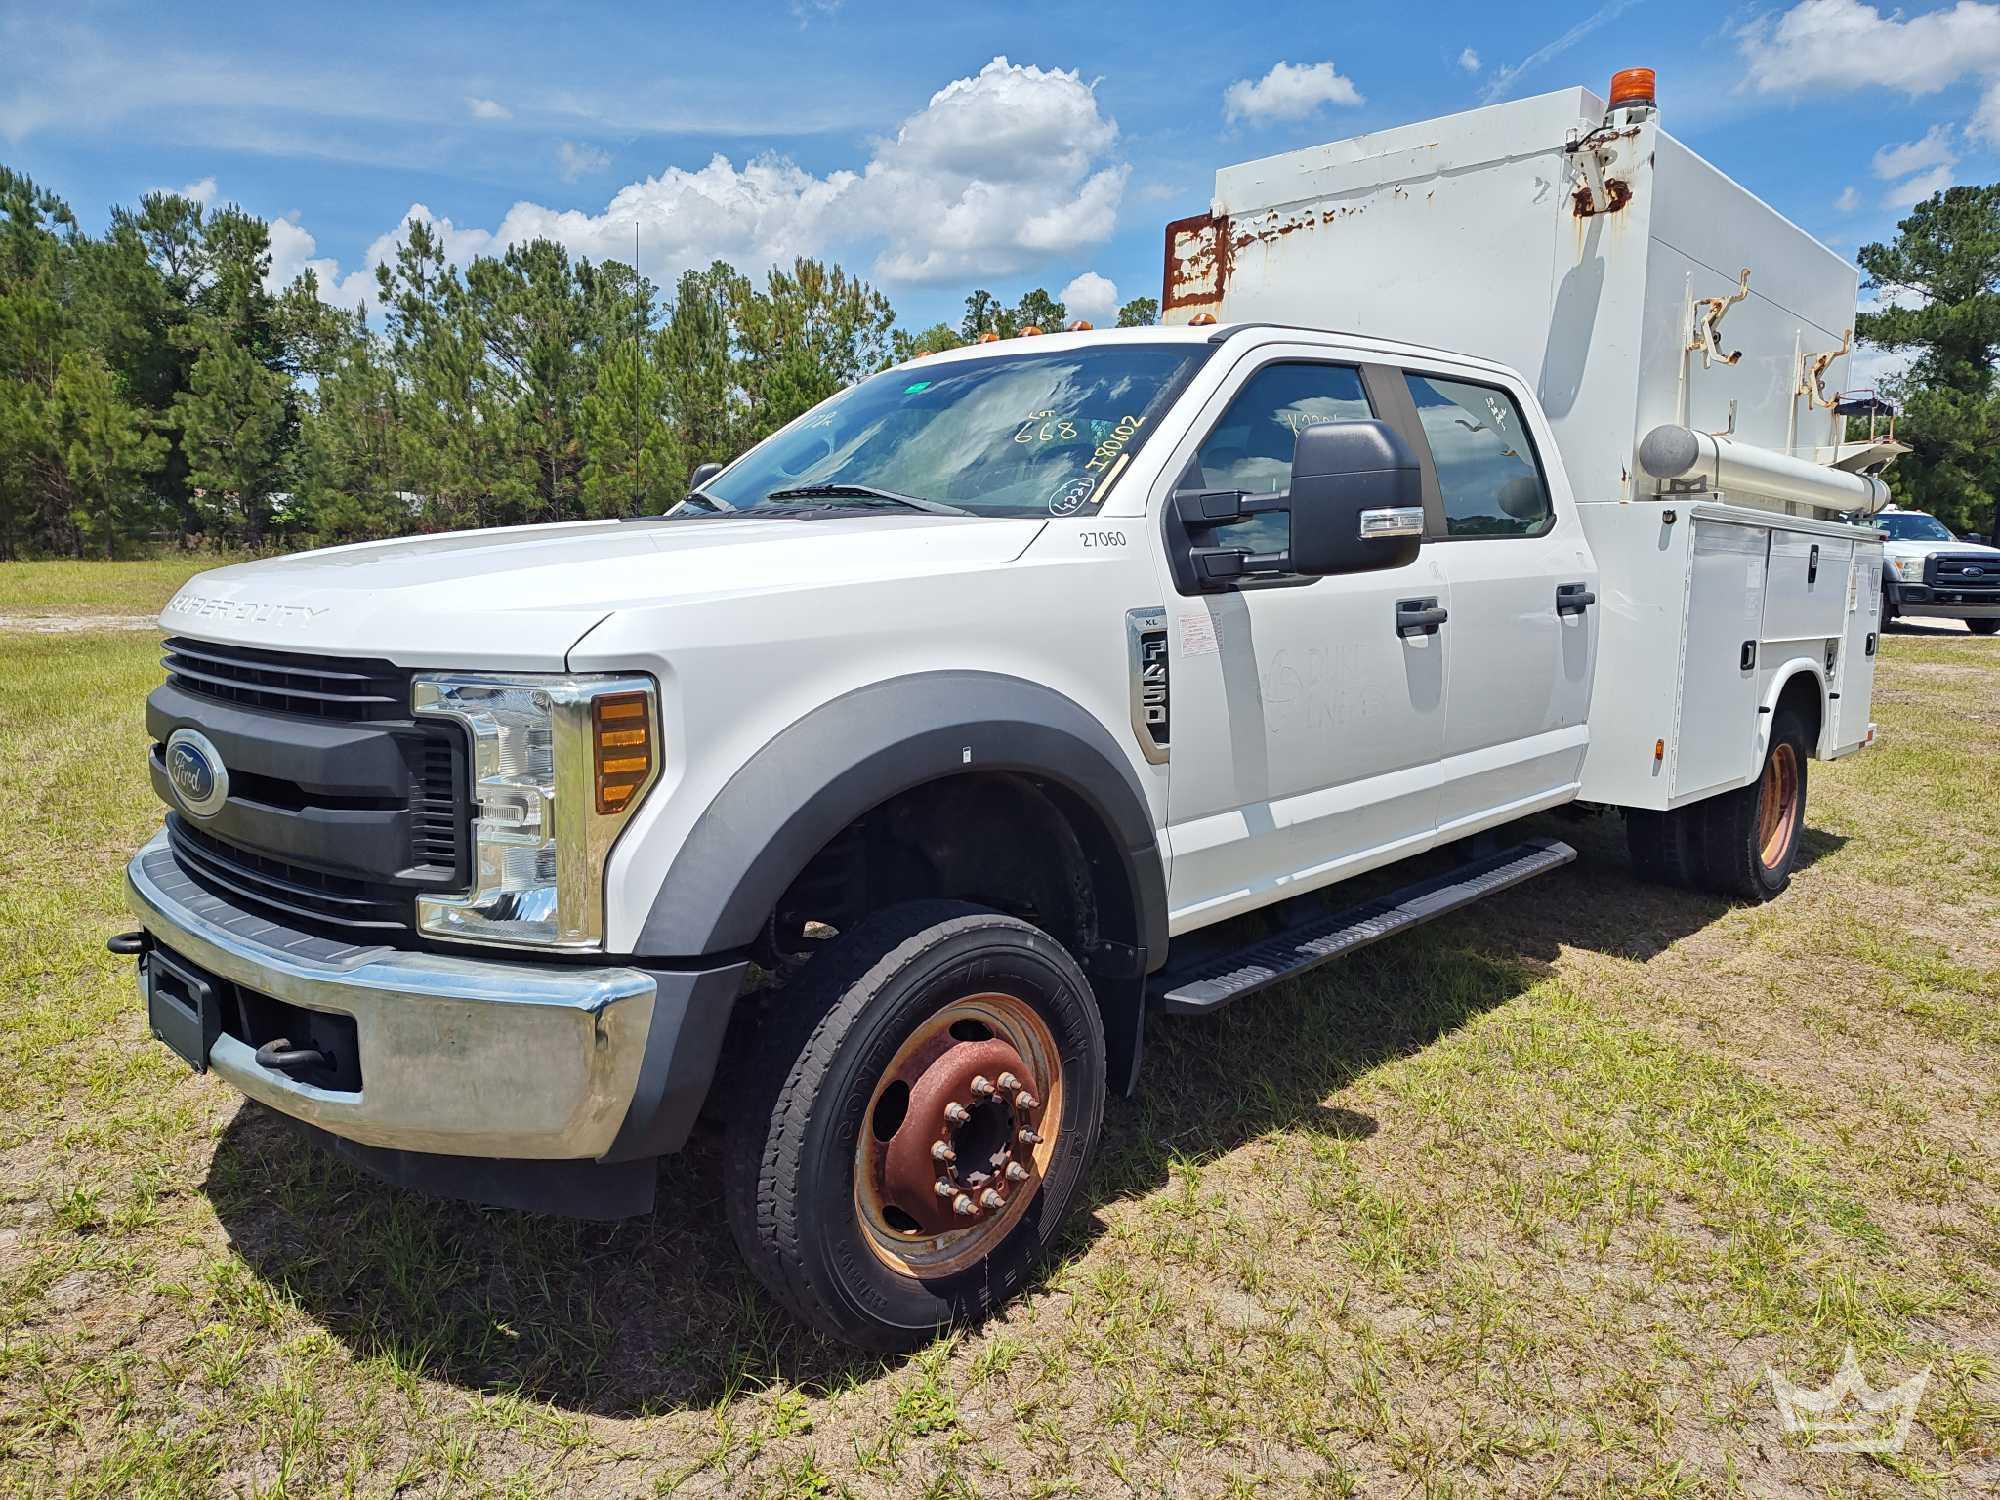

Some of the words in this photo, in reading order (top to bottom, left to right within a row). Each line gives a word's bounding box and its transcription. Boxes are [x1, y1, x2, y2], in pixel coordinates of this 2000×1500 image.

[1014, 421, 1078, 443] 668
[1080, 531, 1127, 547] 27060
[1145, 618, 1159, 626] XL
[173, 750, 201, 793] Ford
